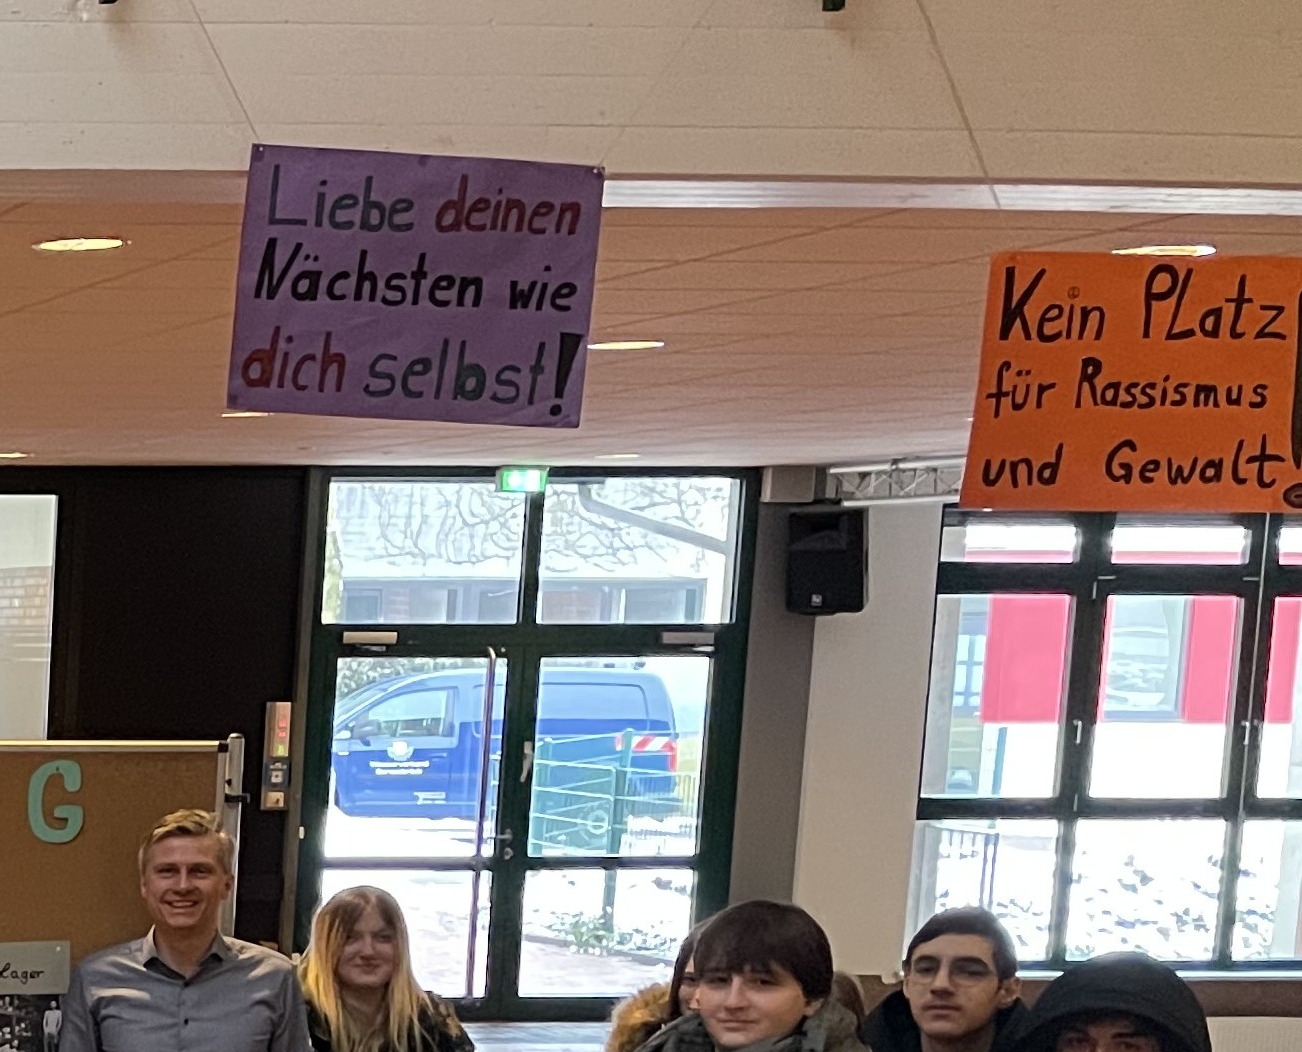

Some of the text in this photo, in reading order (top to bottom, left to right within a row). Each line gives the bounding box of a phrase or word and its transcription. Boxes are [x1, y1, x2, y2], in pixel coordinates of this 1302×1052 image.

[268, 164, 582, 236] Liebe deinen
[254, 237, 578, 312] Nächsten wie
[999, 266, 1105, 343] Kein
[241, 326, 584, 417] dich selbst!
[986, 356, 1269, 418] für Rassismus
[981, 442, 1064, 489] und
